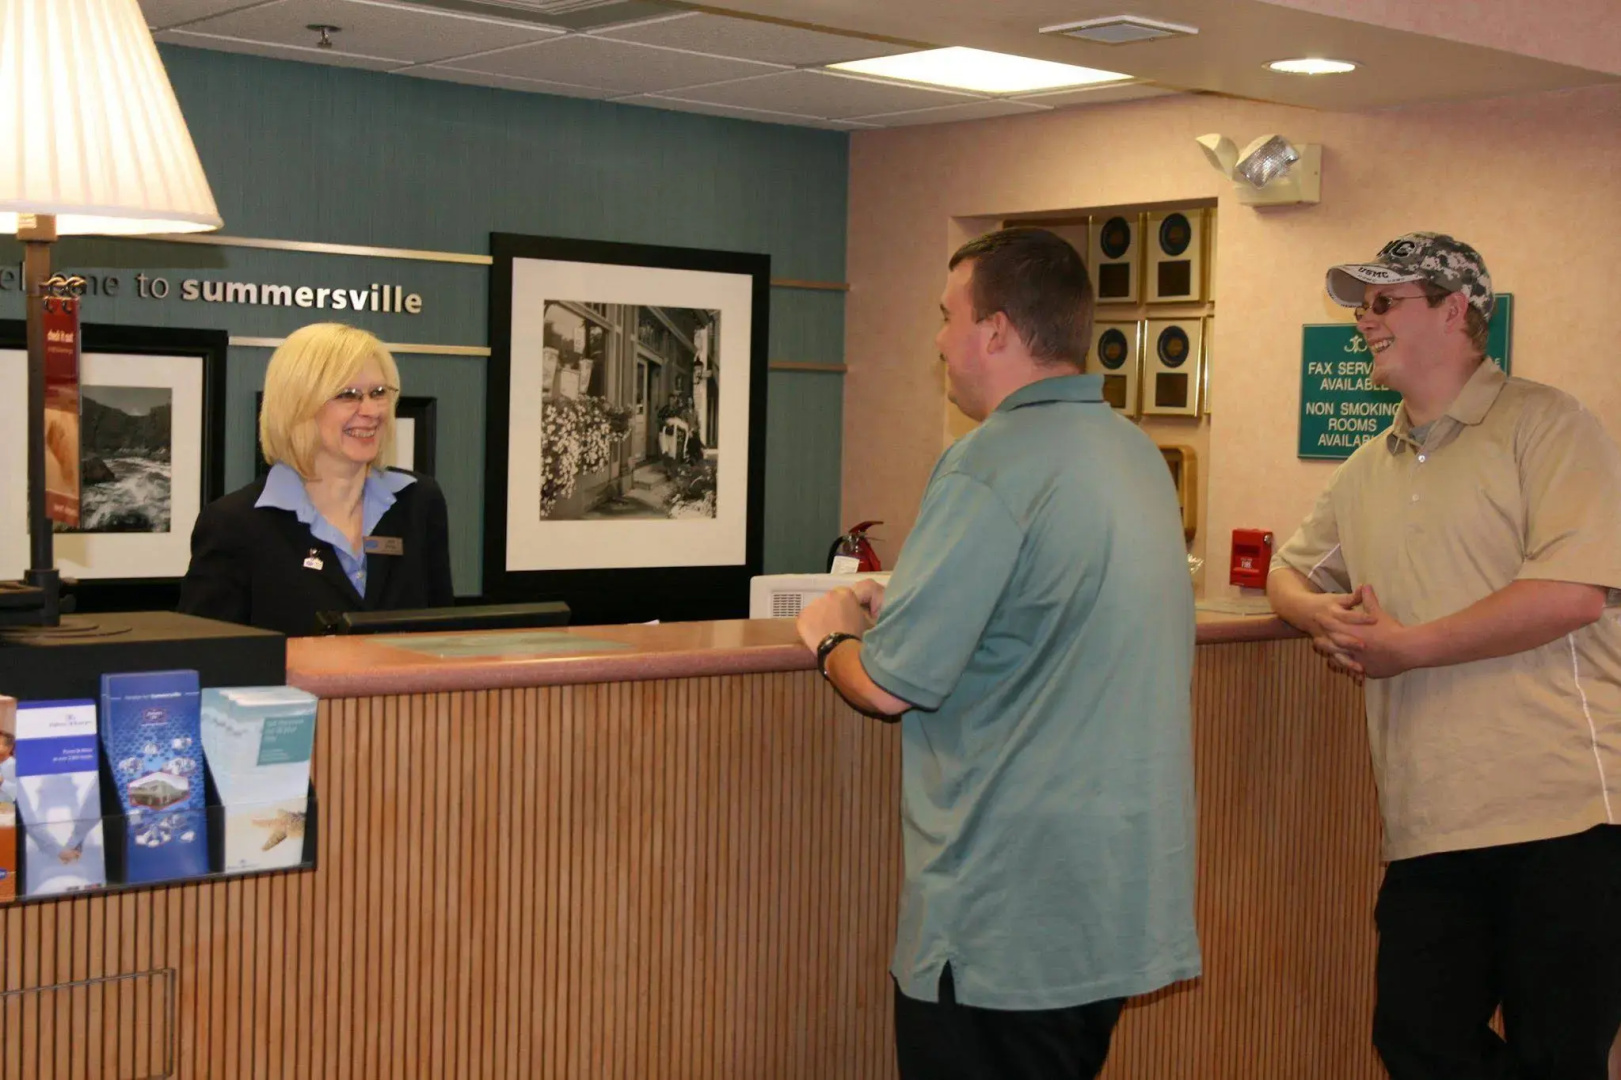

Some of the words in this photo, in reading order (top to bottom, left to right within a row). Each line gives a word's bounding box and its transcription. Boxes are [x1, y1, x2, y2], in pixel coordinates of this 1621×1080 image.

[1358, 266, 1389, 279] USMC
[0, 261, 119, 297] elome
[136, 272, 169, 299] to
[181, 278, 423, 314] summersville
[1308, 362, 1333, 375] FAX
[1338, 362, 1374, 375] SERV
[1306, 402, 1334, 415] NON
[1328, 418, 1377, 432] ROOMS
[1318, 434, 1376, 447] AVAILAB
